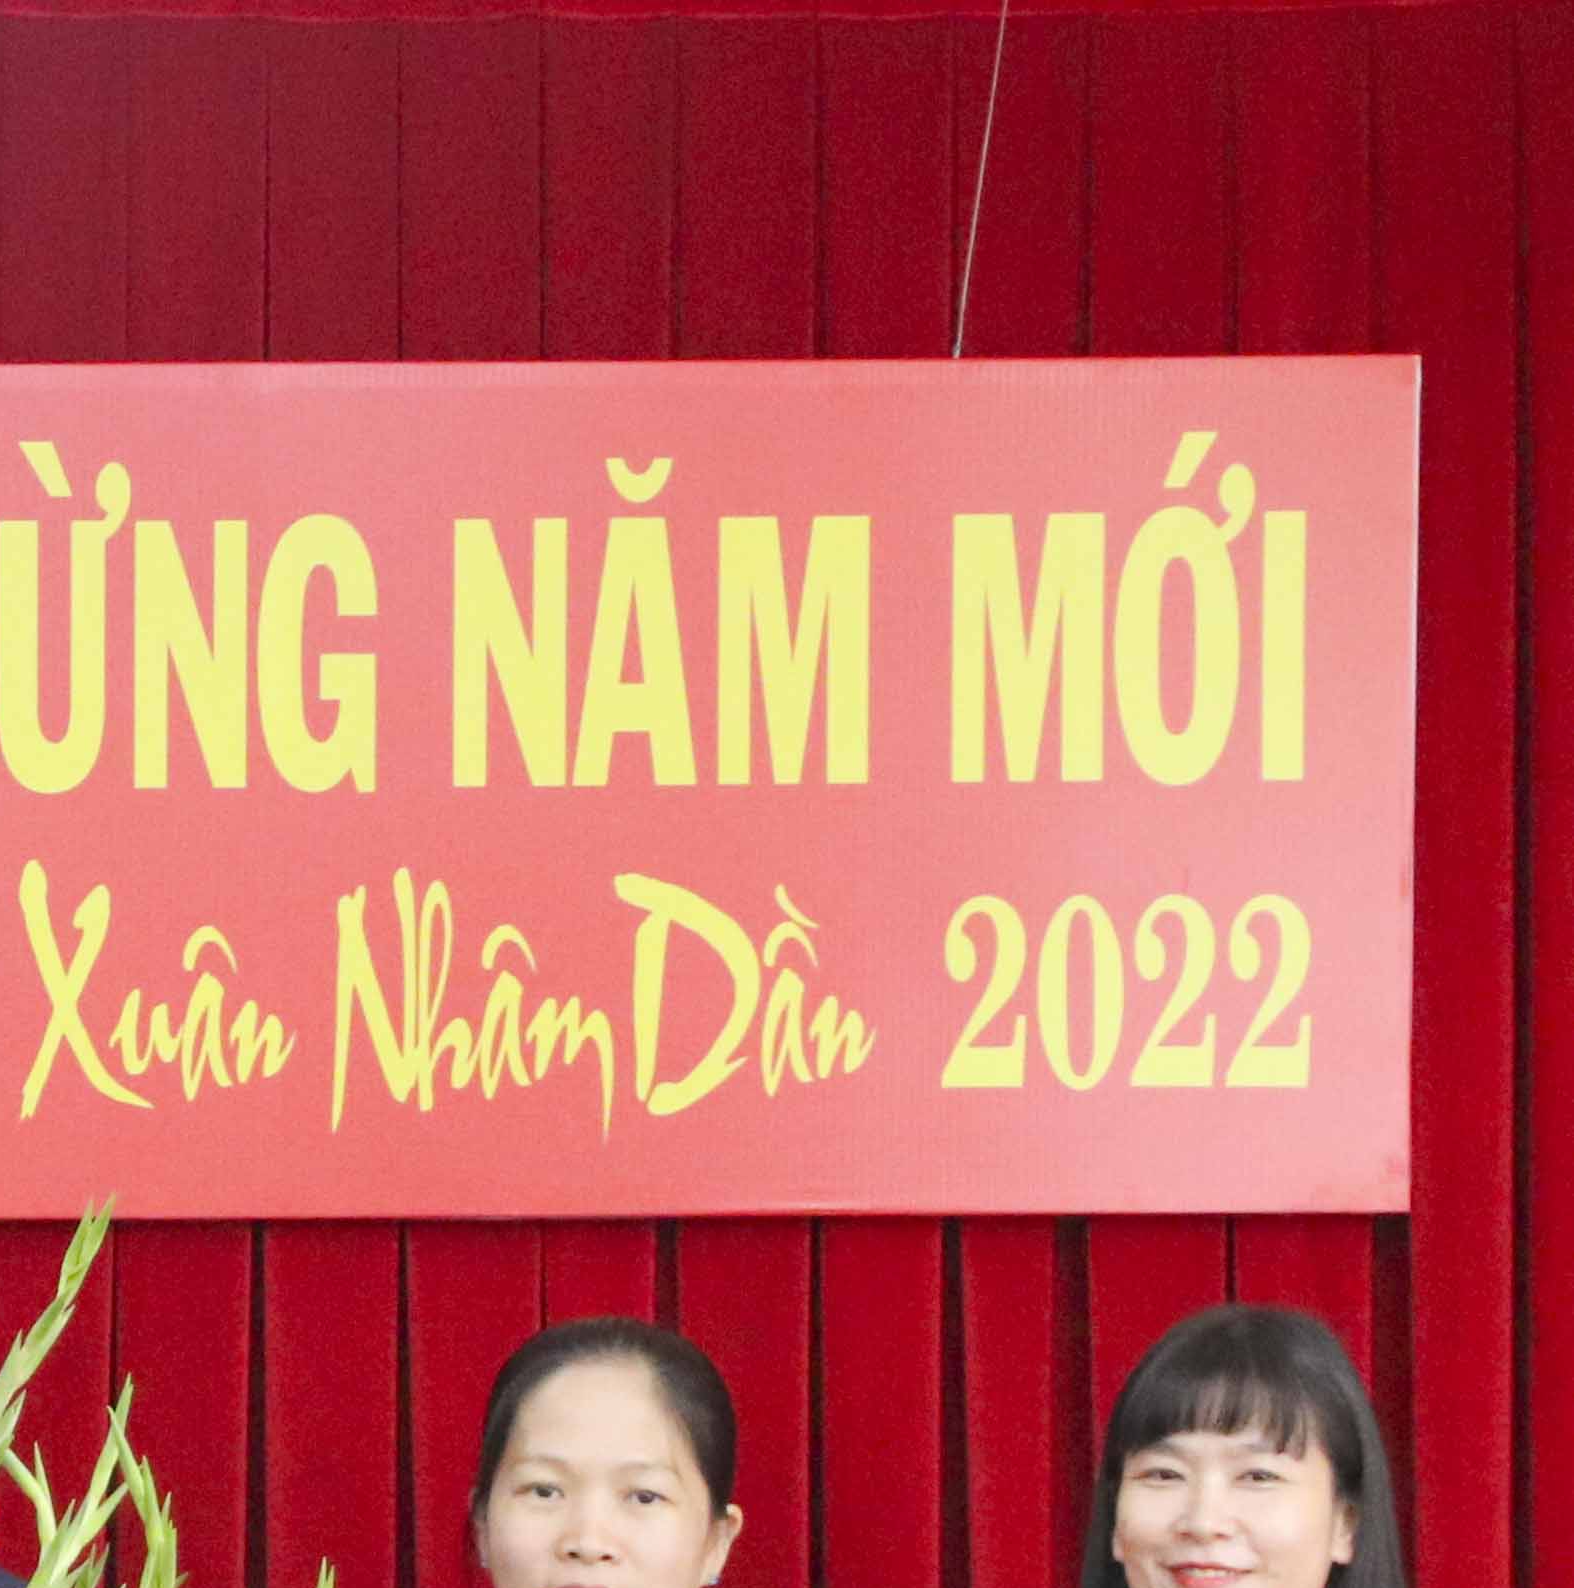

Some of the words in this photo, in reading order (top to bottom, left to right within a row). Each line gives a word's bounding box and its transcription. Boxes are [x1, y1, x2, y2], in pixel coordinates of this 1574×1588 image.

[452, 457, 871, 788] NĂM
[951, 430, 1307, 785] MỚI
[18, 858, 296, 1118] Xuân
[331, 864, 616, 1138] Nhâm
[612, 872, 876, 1114] Dần
[942, 895, 1312, 1090] 2022
